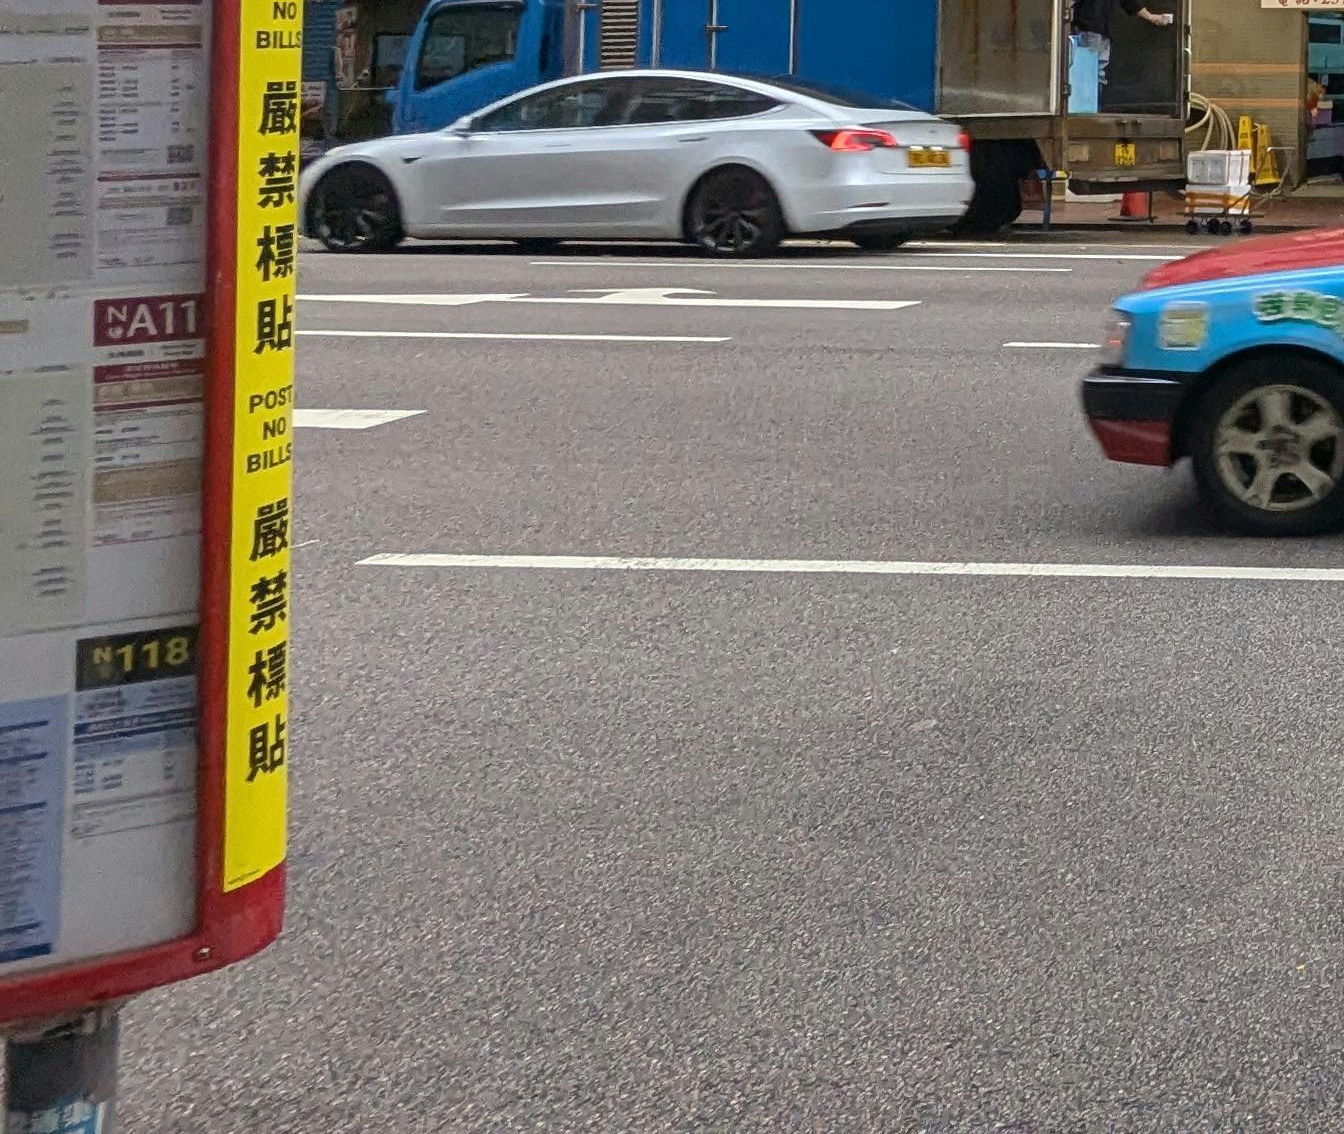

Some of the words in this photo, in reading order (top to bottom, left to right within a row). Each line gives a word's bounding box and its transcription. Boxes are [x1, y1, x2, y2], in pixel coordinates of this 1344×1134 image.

[273, 1, 297, 20] NO
[256, 30, 303, 49] BILLS
[254, 81, 299, 355] 嚴禁標貼
[249, 383, 293, 414] POST
[262, 416, 287, 441] NO
[246, 444, 293, 474] BILLS
[93, 637, 190, 672] N118
[245, 497, 289, 783] 嚴禁標貼
